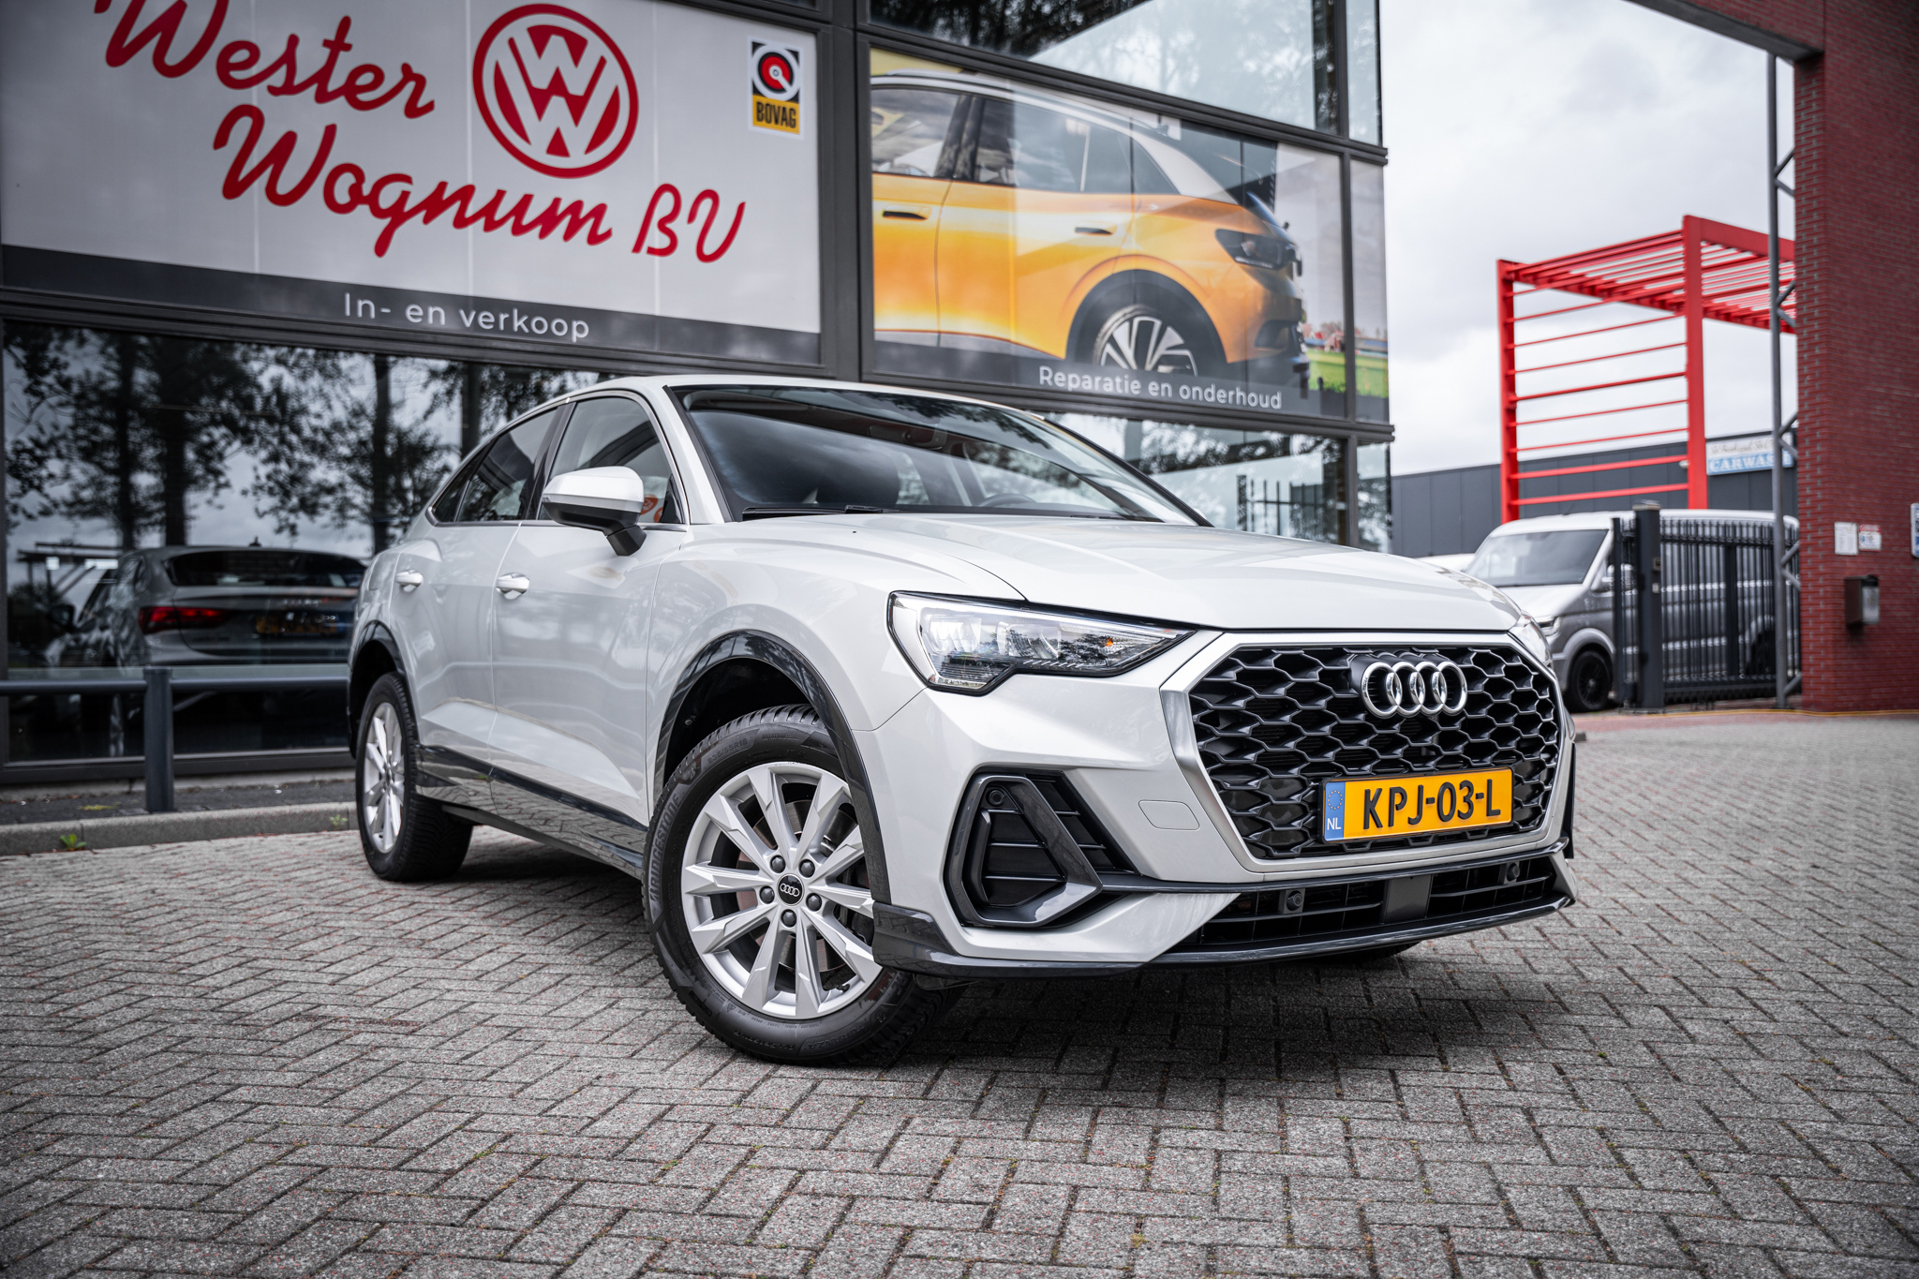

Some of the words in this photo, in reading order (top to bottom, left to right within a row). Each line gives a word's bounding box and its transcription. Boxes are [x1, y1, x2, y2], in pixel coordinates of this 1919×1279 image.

[94, 0, 435, 119] Wester
[755, 101, 797, 129] BOVAG
[212, 104, 613, 258] Wognum
[631, 183, 746, 263] BV
[344, 293, 391, 319] In-
[405, 303, 446, 326] en
[459, 308, 590, 343] verkoop
[1039, 366, 1141, 395] Reparatie
[1148, 381, 1172, 398] en
[1179, 384, 1282, 410] onderhoud
[1327, 817, 1341, 831] NL
[1363, 779, 1501, 830] KPJ-03-L
[648, 793, 680, 901] BRIDGESTONE
